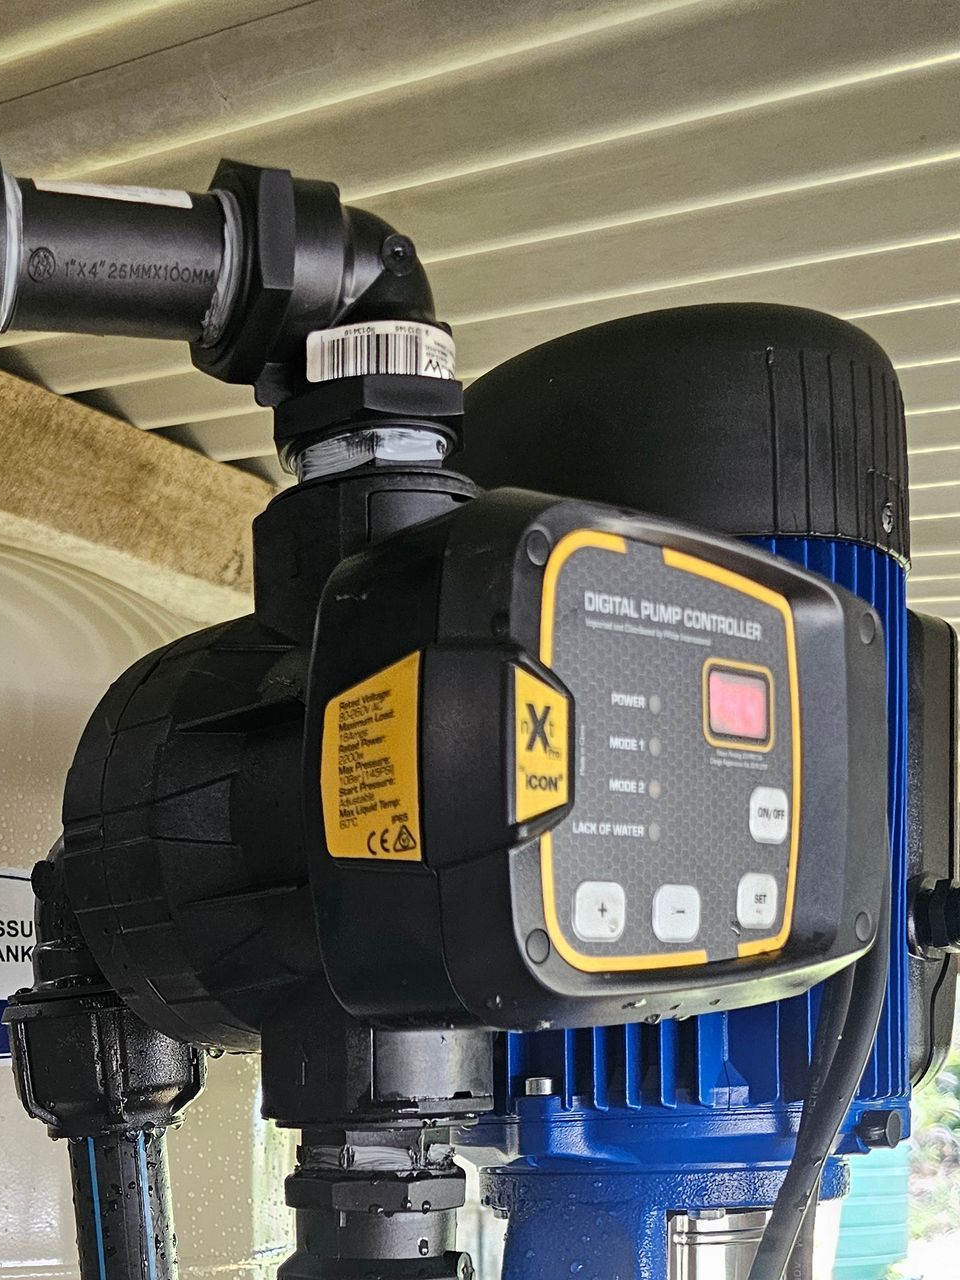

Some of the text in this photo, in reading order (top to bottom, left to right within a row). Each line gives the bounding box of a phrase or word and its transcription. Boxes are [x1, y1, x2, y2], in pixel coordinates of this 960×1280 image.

[584, 590, 640, 618] DIGITAL
[640, 602, 683, 625] PUMP
[683, 608, 762, 641] CONTROLLER
[611, 692, 646, 709] POWER
[609, 735, 639, 751] MODE
[609, 779, 638, 793] MODE
[572, 821, 645, 838] LACK OF WATER
[753, 894, 767, 905] SET
